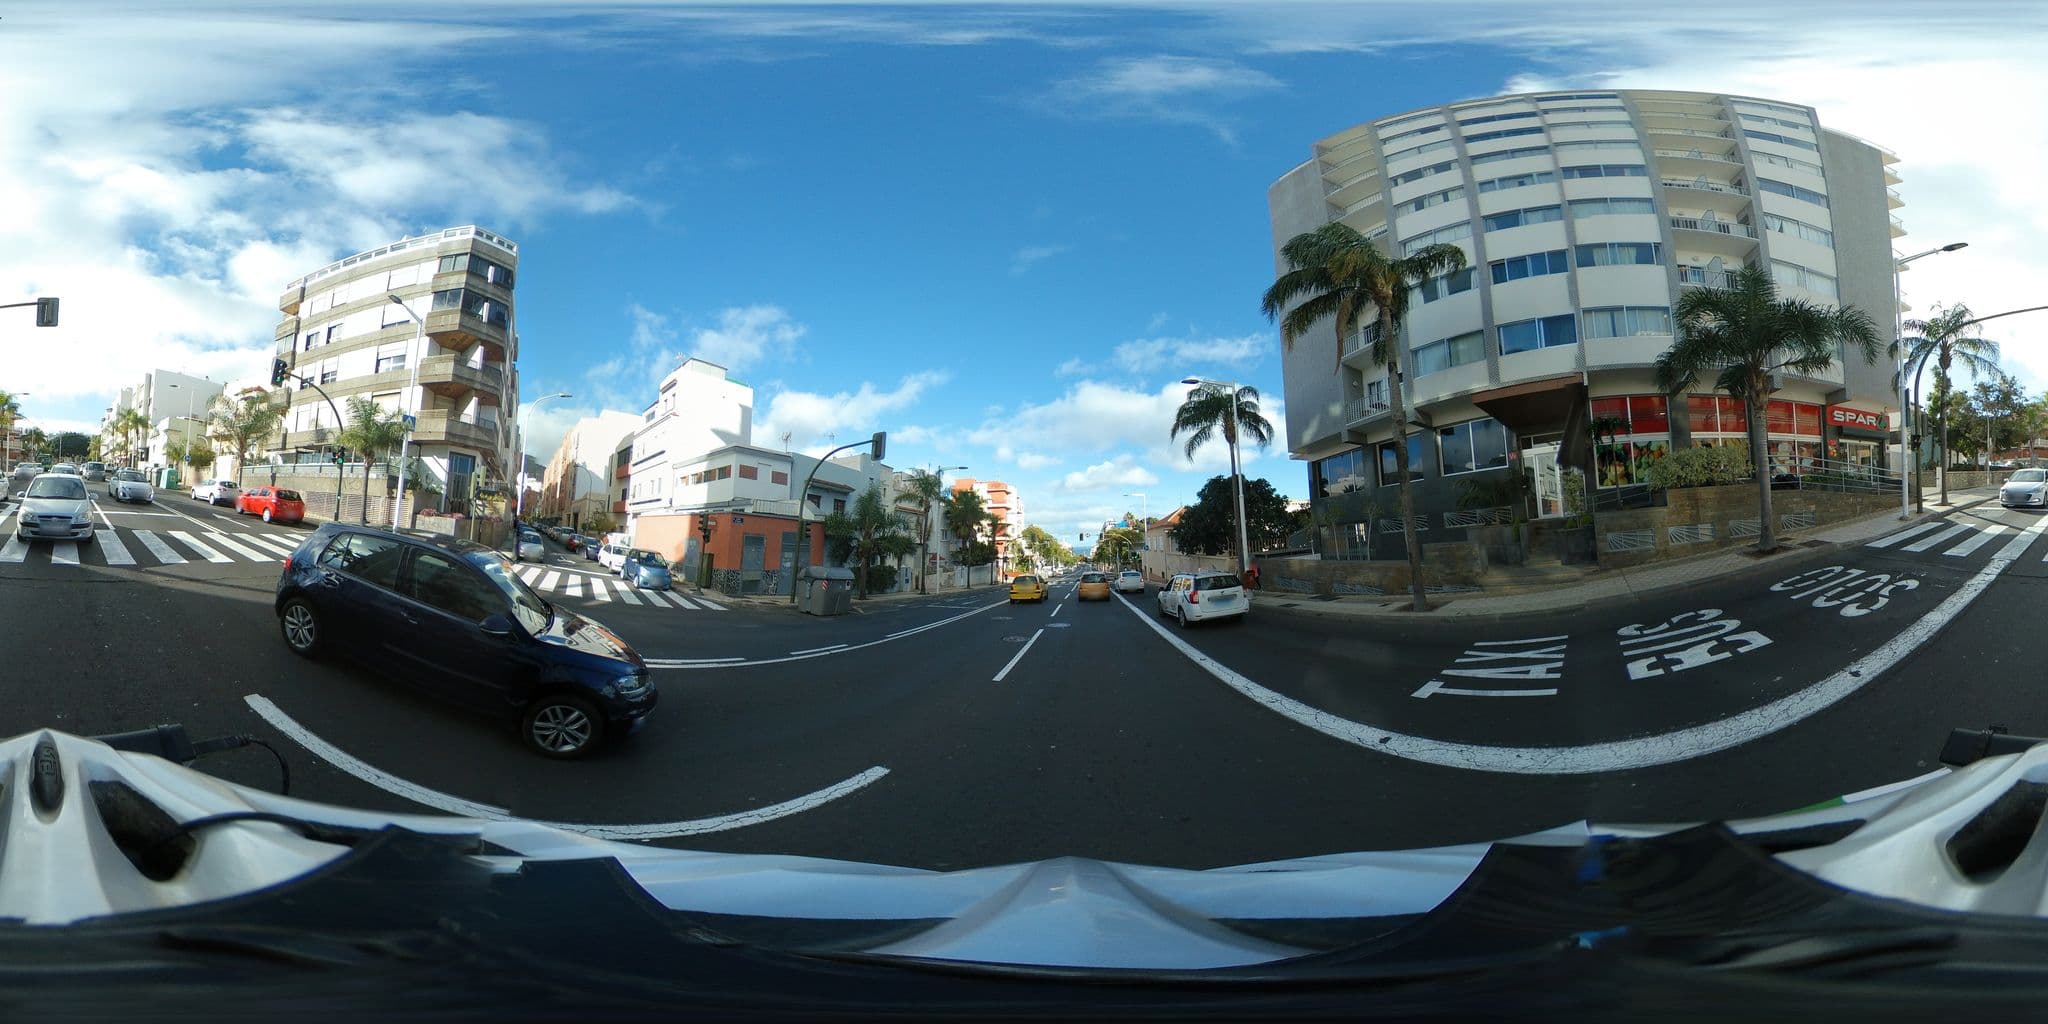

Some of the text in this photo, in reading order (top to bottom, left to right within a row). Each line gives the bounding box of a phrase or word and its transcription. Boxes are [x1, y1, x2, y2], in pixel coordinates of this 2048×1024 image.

[1833, 410, 1877, 426] SPAR
[1770, 566, 1919, 617] SOLO
[1410, 635, 1569, 698] TAXI
[1617, 609, 1774, 680] BUS
